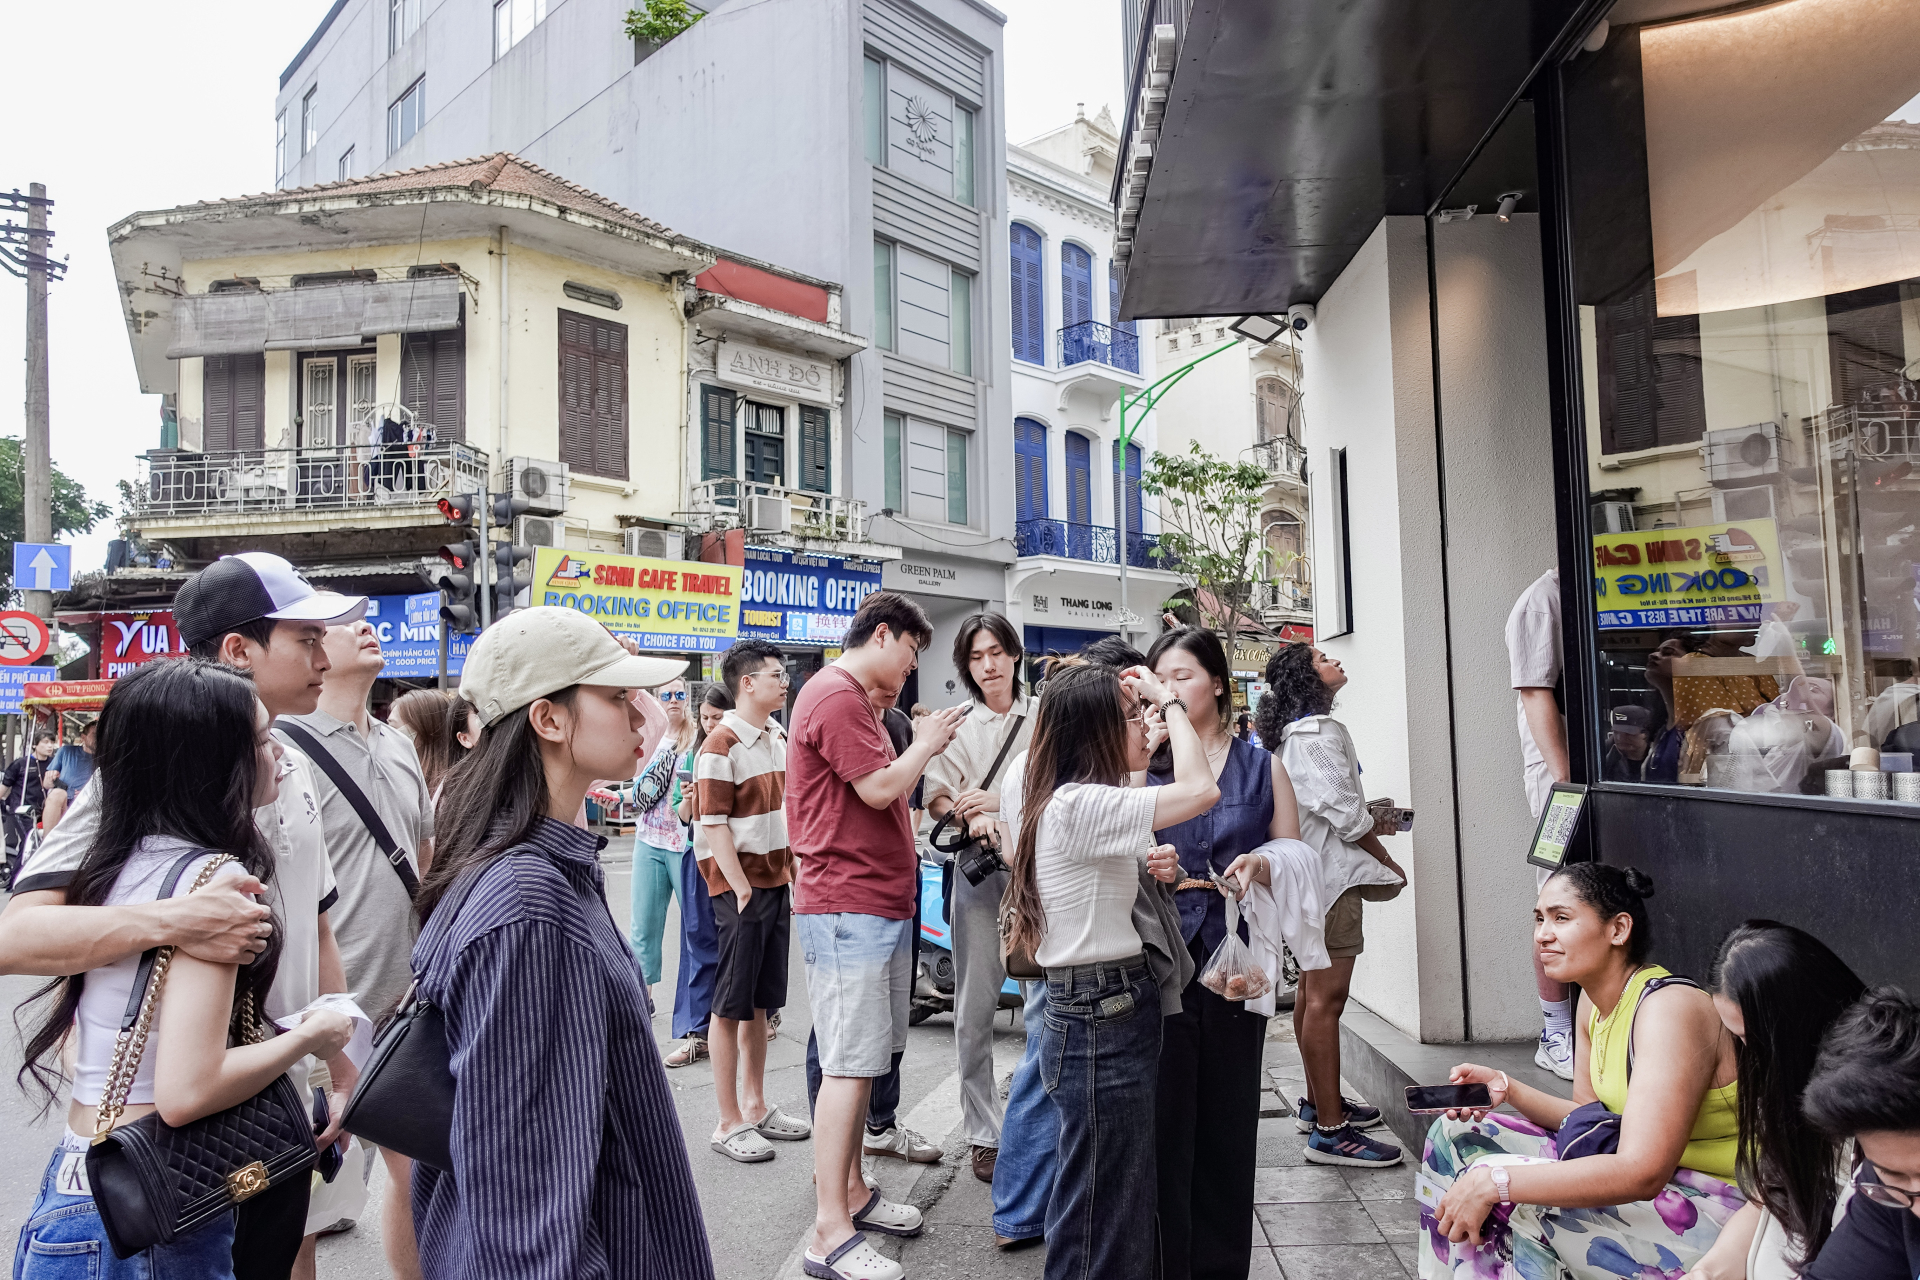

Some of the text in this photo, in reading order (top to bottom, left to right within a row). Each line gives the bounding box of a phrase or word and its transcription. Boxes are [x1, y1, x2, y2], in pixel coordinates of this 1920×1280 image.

[730, 351, 782, 378] ANH
[758, 552, 771, 562] LOCAL
[772, 553, 783, 563] TOUR
[818, 559, 829, 568] NAM
[863, 563, 881, 574] EXPRESS
[900, 563, 956, 581] GREEN PALM
[593, 564, 732, 596] SINH CAFE TRAVEL
[918, 579, 941, 587] GALLERY
[742, 569, 880, 611] BOOKING OFFIC
[544, 591, 731, 623] BOOKING OFFICE
[1060, 597, 1089, 609] THANG
[1092, 600, 1113, 611] LONG
[743, 610, 782, 627] TOURIST
[400, 621, 440, 642] MIN
[644, 633, 679, 648] CHOICE
[680, 635, 697, 649] FOR
[699, 636, 717, 650] YOU
[395, 658, 416, 666] GOOD
[416, 657, 437, 666] PRICE
[66, 685, 81, 694] HUY
